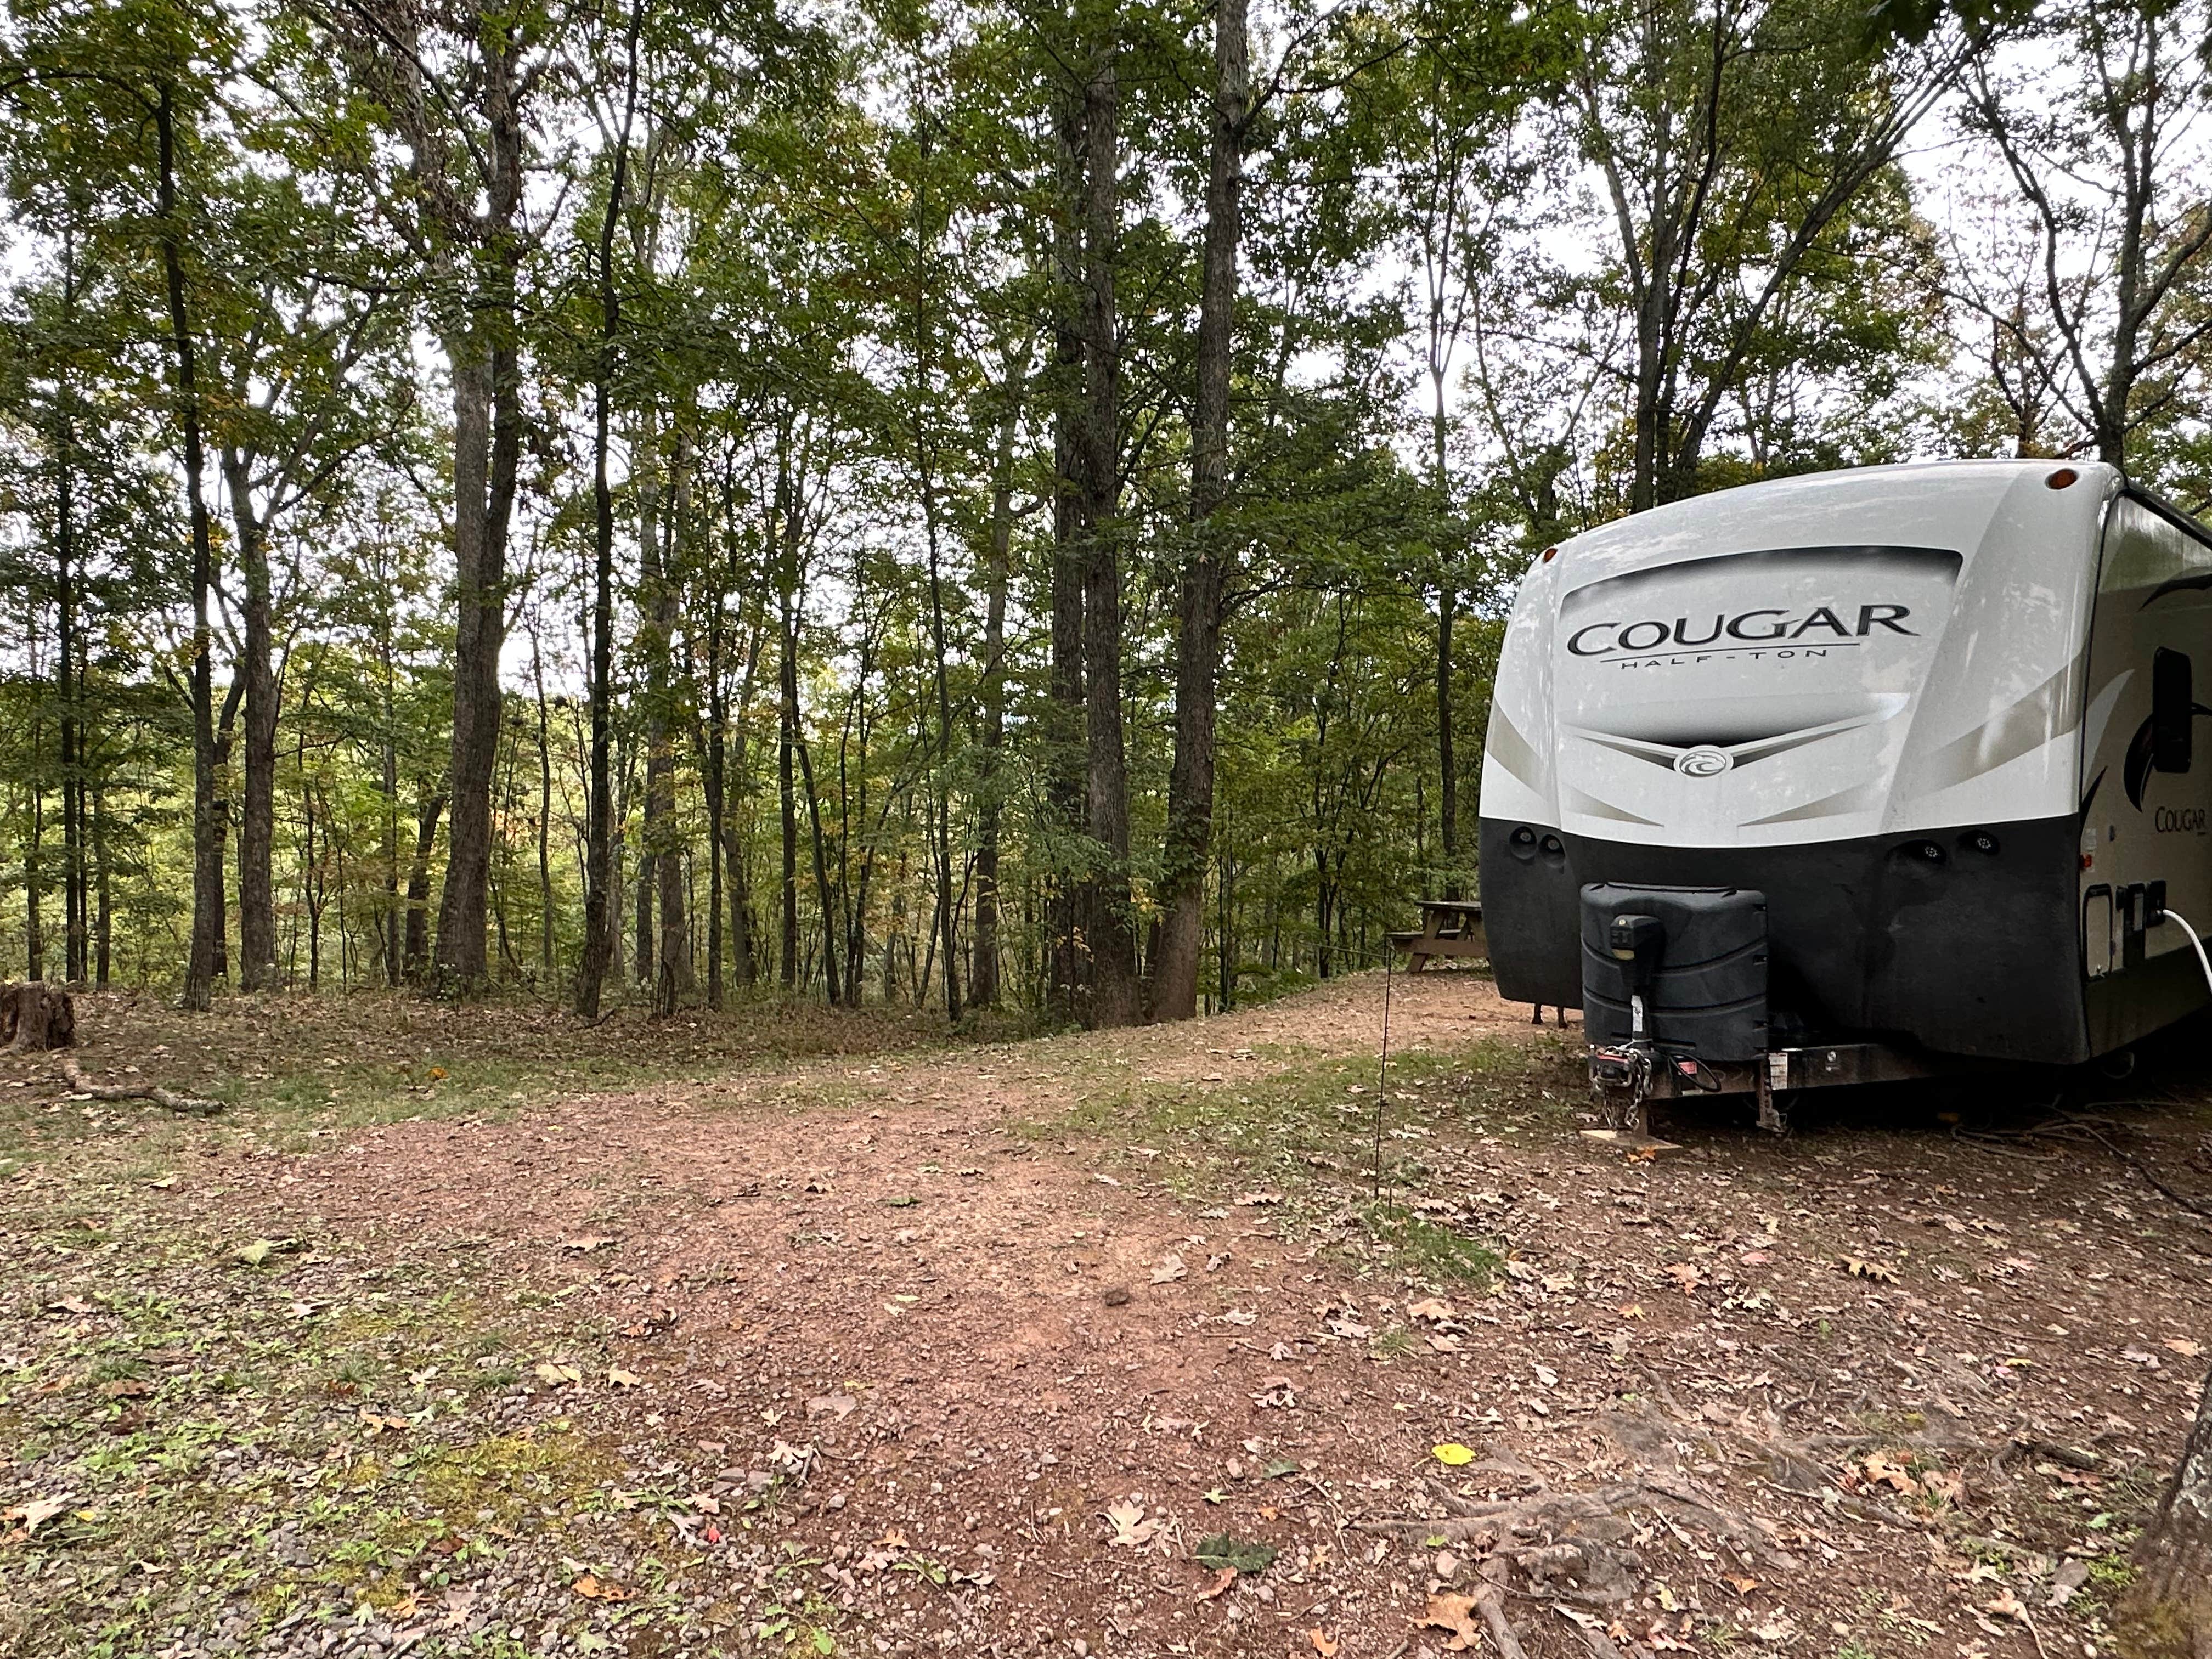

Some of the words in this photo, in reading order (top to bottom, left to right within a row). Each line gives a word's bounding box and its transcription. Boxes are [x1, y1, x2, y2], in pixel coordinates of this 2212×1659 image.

[1567, 605, 1920, 656] COUGAR
[1621, 650, 1827, 669] HALF-TON
[2156, 806, 2205, 832] COUGAR
